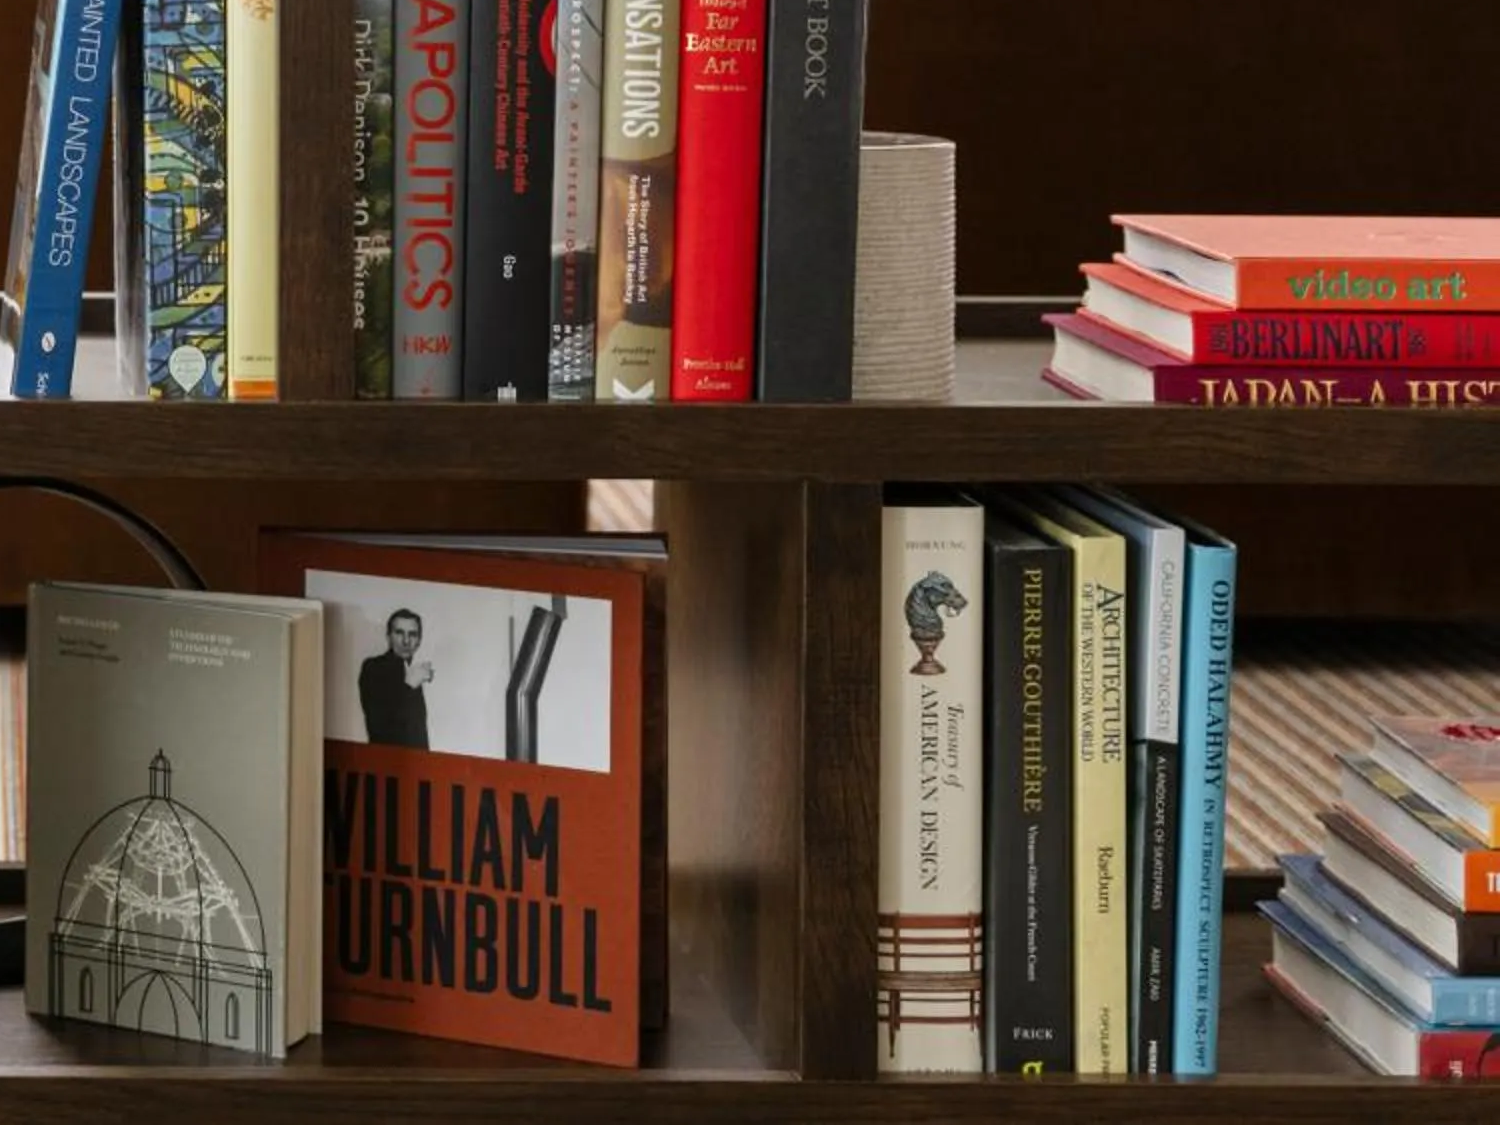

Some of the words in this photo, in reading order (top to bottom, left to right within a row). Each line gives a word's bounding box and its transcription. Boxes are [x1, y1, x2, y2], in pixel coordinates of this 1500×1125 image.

[685, 33, 757, 53] Eastern
[707, 13, 739, 31] Far
[517, 60, 531, 83] and
[703, 56, 738, 74] Art
[804, 18, 831, 100] BOOK
[516, 87, 530, 108] the
[48, 96, 93, 267] LANDSCAPES
[496, 148, 510, 171] Art
[629, 176, 639, 200] from
[641, 177, 651, 197] The
[626, 203, 638, 247] Hogarth
[638, 200, 650, 230] Story
[639, 232, 650, 244] of
[627, 250, 636, 261] to
[638, 246, 649, 282] British
[638, 285, 648, 303] Art
[1286, 269, 1397, 300] video
[1406, 272, 1468, 300] art
[1231, 320, 1404, 360] BERLINART
[1023, 568, 1044, 659] PIERRE
[1081, 583, 1095, 604] OF
[1158, 561, 1176, 652] CALIFORNIA
[1209, 580, 1232, 652] ODED
[1081, 607, 1095, 636] THE
[1081, 638, 1095, 707] WESTERN
[1097, 583, 1125, 764] ARCHITECTURE
[1156, 654, 1172, 733] CONCRETE
[920, 684, 940, 801] AMERICAN
[941, 702, 965, 768] Treasury
[1023, 664, 1048, 812] GOUTHIÈRE
[1081, 709, 1095, 762] WORLD
[1203, 659, 1228, 790] HALAHMY
[941, 773, 965, 792] of
[1155, 765, 1167, 826] LANDSCAPE
[1202, 798, 1216, 814] IN
[920, 811, 940, 891] DESIGN
[1154, 828, 1165, 843] OF
[1097, 845, 1115, 914] Raeburn
[1151, 846, 1164, 911] SKATEPARKS
[1198, 821, 1214, 913] RETROSPECT
[326, 873, 612, 1012] URNBULL
[1196, 920, 1212, 1003] SCULPTURE
[1013, 1026, 1054, 1041] FRICK
[1100, 1006, 1112, 1057] POPULAR
[1193, 1007, 1209, 1068] 1962-1997
